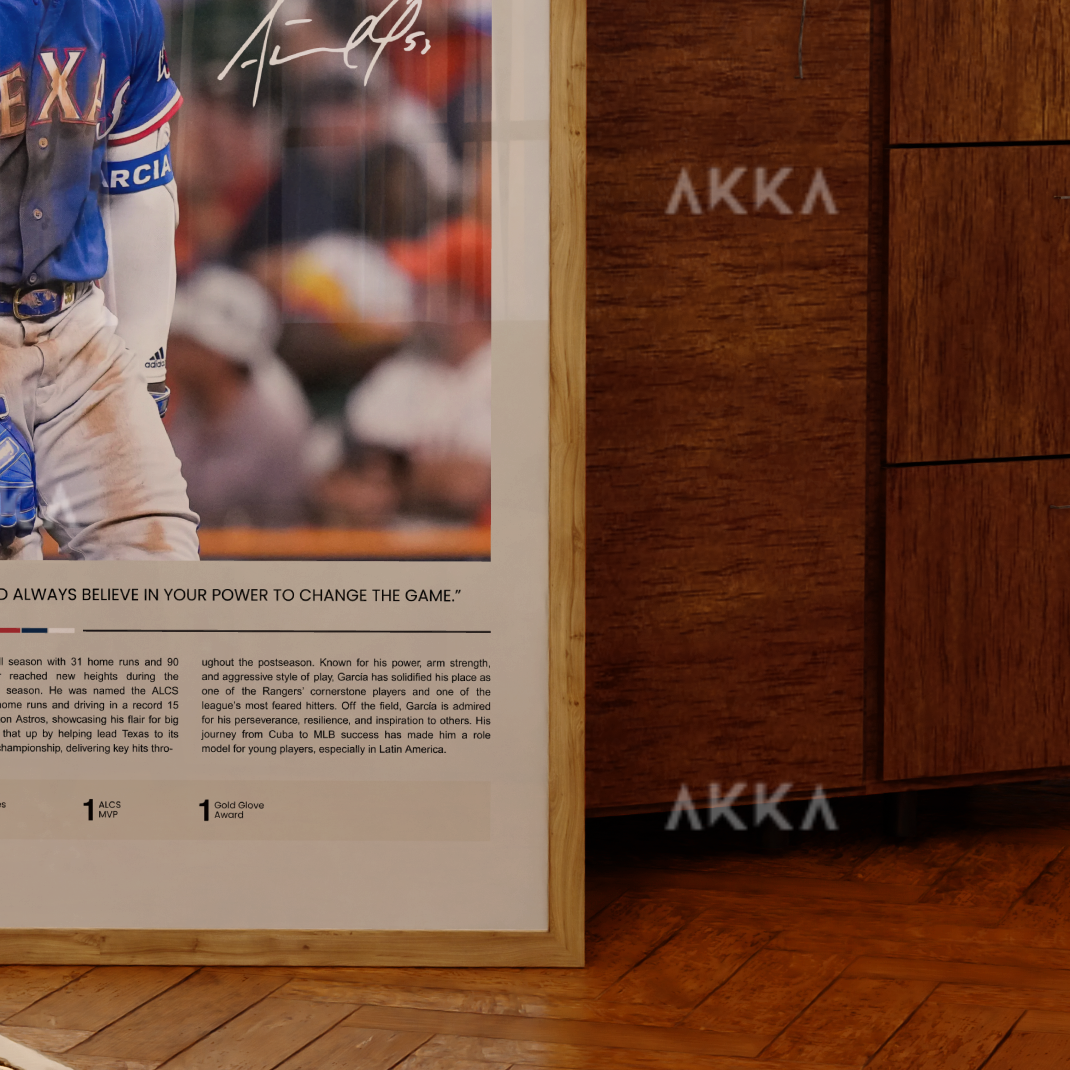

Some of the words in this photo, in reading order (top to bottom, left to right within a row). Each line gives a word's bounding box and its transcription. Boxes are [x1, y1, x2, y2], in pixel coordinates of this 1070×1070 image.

[12, 587, 76, 600] ALWAYS
[82, 588, 138, 601] BELIEVE
[144, 588, 158, 601] IN
[163, 588, 206, 601] YOUR
[212, 588, 268, 601] POWER
[273, 588, 294, 601] TO
[299, 588, 367, 601] CHANGE
[371, 589, 400, 601] THE
[405, 589, 461, 601] GAME.”
[8, 658, 42, 666] season
[46, 657, 66, 665] with
[70, 657, 81, 666] 31
[87, 657, 114, 666] home
[144, 657, 162, 666] and
[166, 657, 178, 666] 90
[201, 657, 234, 668] ughout
[238, 657, 253, 666] the
[258, 658, 314, 668] postseason.
[319, 657, 351, 667] Known
[356, 657, 369, 667] for
[373, 658, 387, 667] his
[391, 660, 421, 668] power,
[449, 658, 490, 669] strength,
[65, 743, 110, 754] delivering
[113, 743, 129, 754] key
[132, 743, 148, 752] hits
[150, 744, 173, 752] thro-
[201, 744, 230, 752] model
[232, 743, 245, 753] for
[247, 746, 276, 755] young
[279, 744, 315, 755] players,
[318, 744, 365, 755] especially
[368, 744, 376, 753] in
[379, 744, 402, 753] Latin
[404, 744, 446, 753] America.
[83, 798, 94, 821] 1
[98, 801, 121, 809] ALCS
[98, 810, 118, 818] MVP
[199, 799, 209, 821] 1
[214, 801, 236, 809] Gold
[238, 801, 265, 809] Glove
[214, 810, 244, 819] Award
